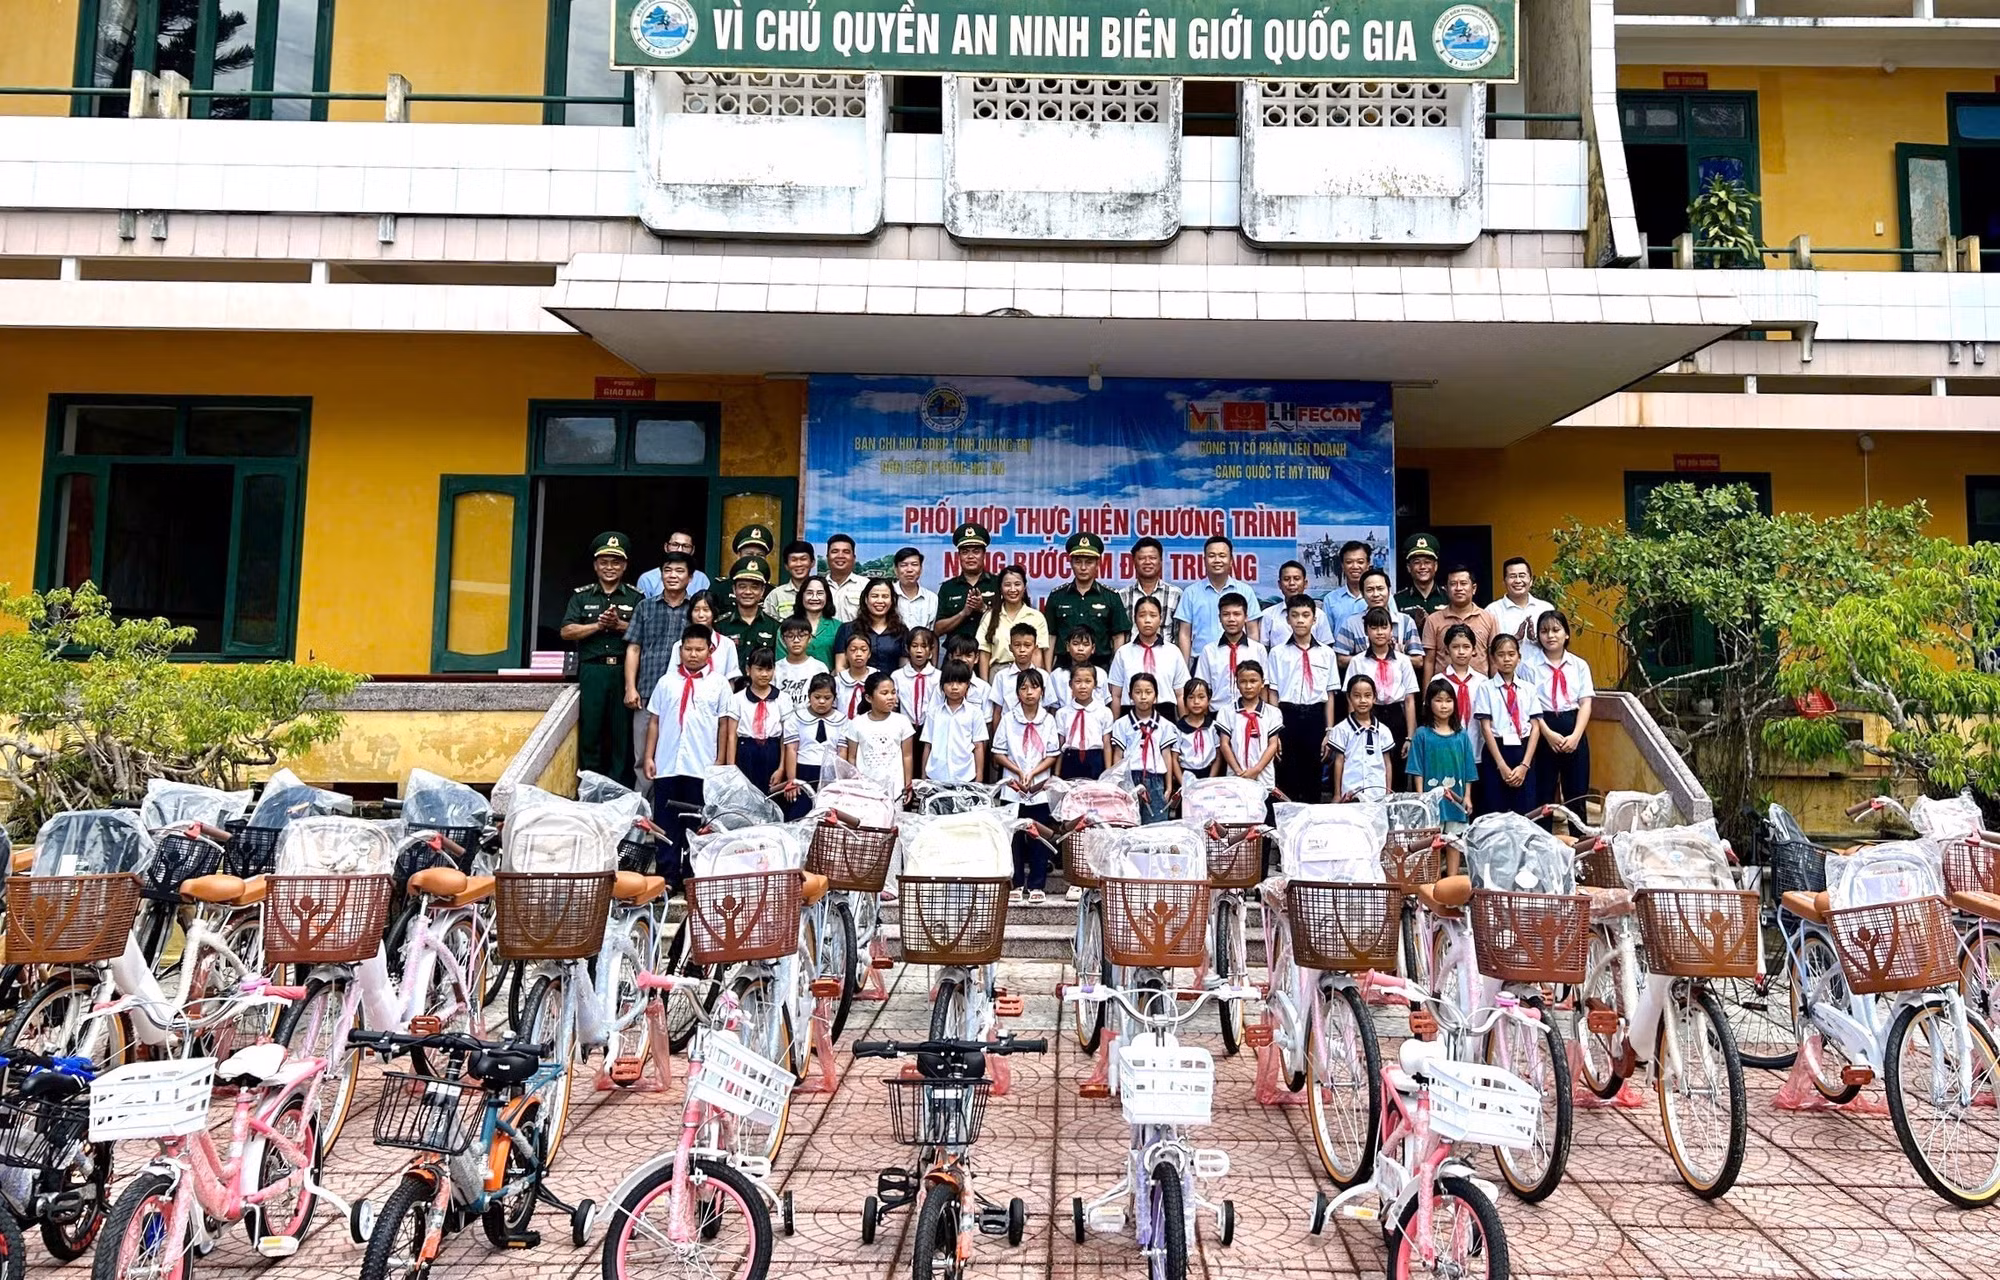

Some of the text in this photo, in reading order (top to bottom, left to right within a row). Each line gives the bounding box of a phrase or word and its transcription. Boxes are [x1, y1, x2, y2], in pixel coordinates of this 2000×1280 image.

[712, 0, 743, 50] VÌ
[755, 0, 821, 52] CHỦ
[832, 0, 939, 57] QUYỀN
[951, 14, 998, 56] AN
[1009, 15, 1090, 58] NINH
[1101, 8, 1176, 59] BIÊN
[1188, 8, 1253, 60] GIỚI
[1264, 7, 1350, 65] QUỐC
[1362, 19, 1417, 61] GIA
[603, 388, 623, 396] GIAO
[1298, 407, 1361, 422] FECON
[854, 436, 876, 451] BAN
[899, 437, 918, 451] HUY
[1199, 439, 1226, 455] CÔNG
[1229, 441, 1240, 455] TY
[1243, 436, 1256, 455] CỔ
[1289, 438, 1310, 456] LIÊN
[1313, 442, 1347, 457] DOANH
[1215, 460, 1331, 480] CẢNG QUỐC TẾ MỸ THỦY
[905, 497, 957, 533] PHỐI
[1015, 505, 1071, 541] THỰC
[1078, 502, 1128, 541] HIỆN
[1136, 506, 1225, 537] CHƯƠNG
[1231, 504, 1297, 537] TRÌNH
[780, 678, 808, 692] START
